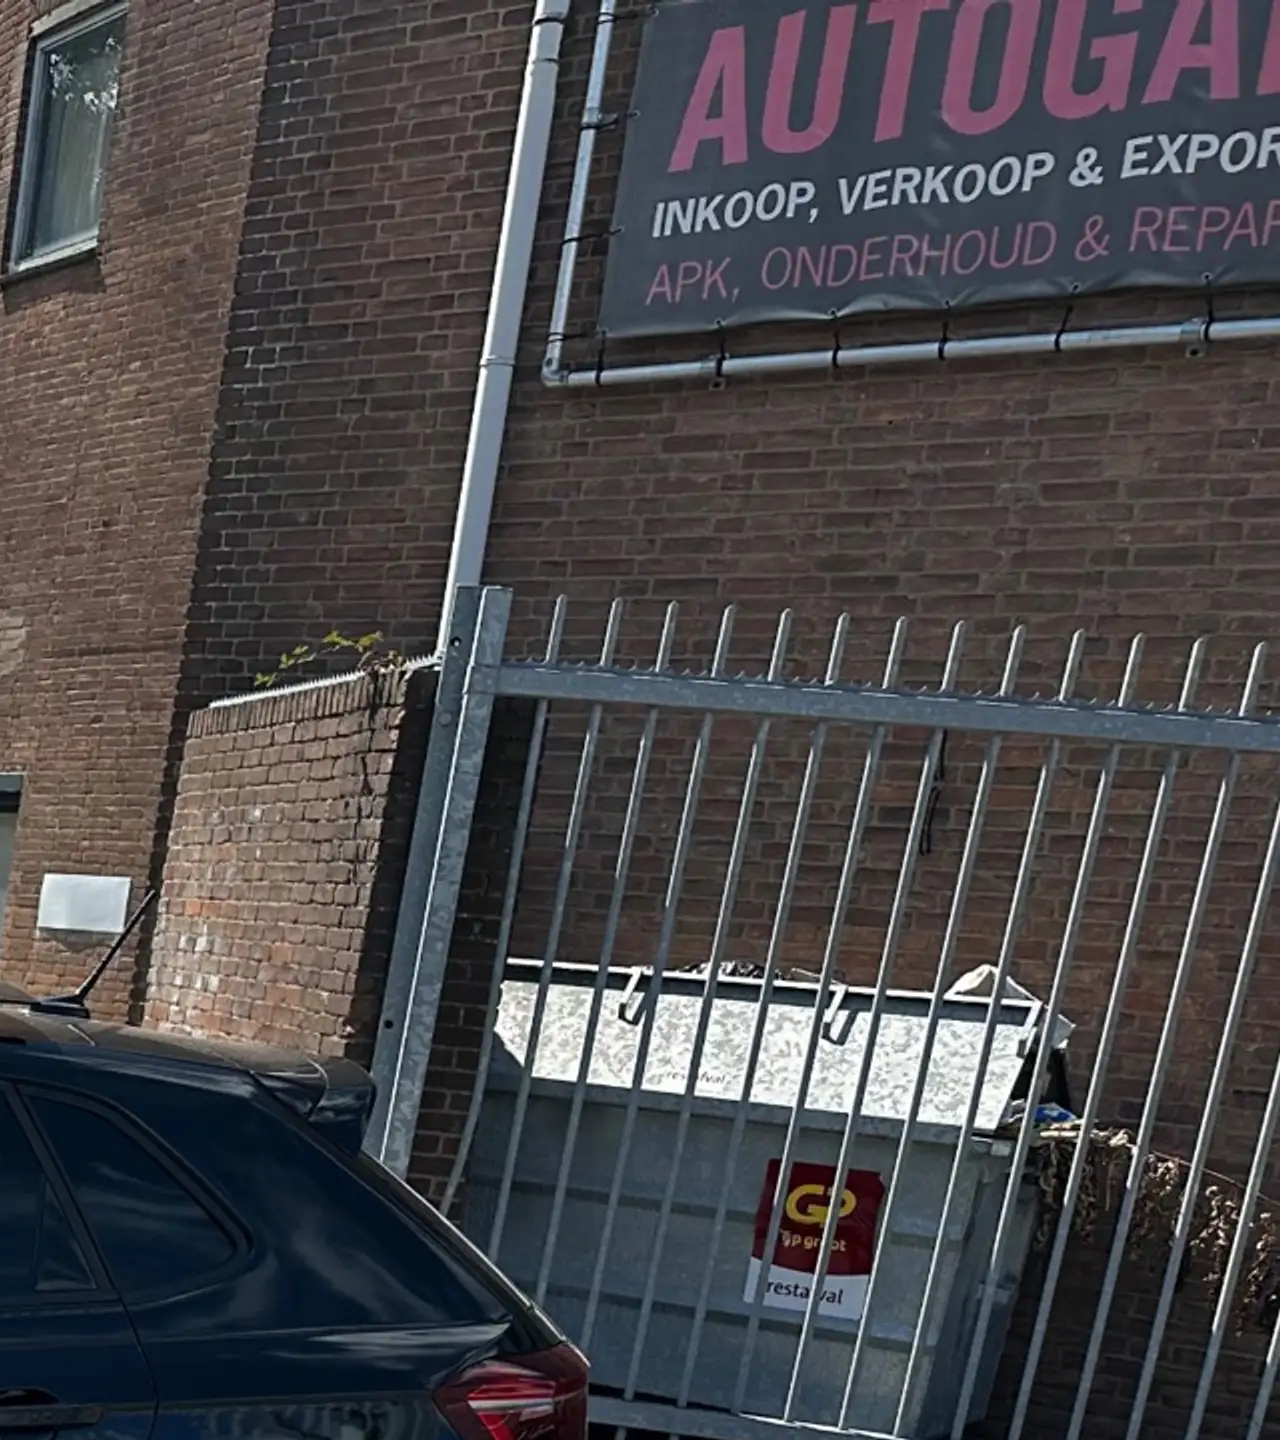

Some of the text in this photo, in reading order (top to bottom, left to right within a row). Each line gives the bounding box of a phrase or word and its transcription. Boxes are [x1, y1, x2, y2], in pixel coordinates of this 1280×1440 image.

[667, 0, 1280, 172] AUTOGA
[652, 180, 818, 237] INKOOP,
[837, 152, 1055, 215] VERKOOP
[1068, 147, 1104, 187] &
[645, 257, 739, 306] APK,
[761, 221, 1057, 290] ONDERHOUD
[1074, 214, 1110, 262] &
